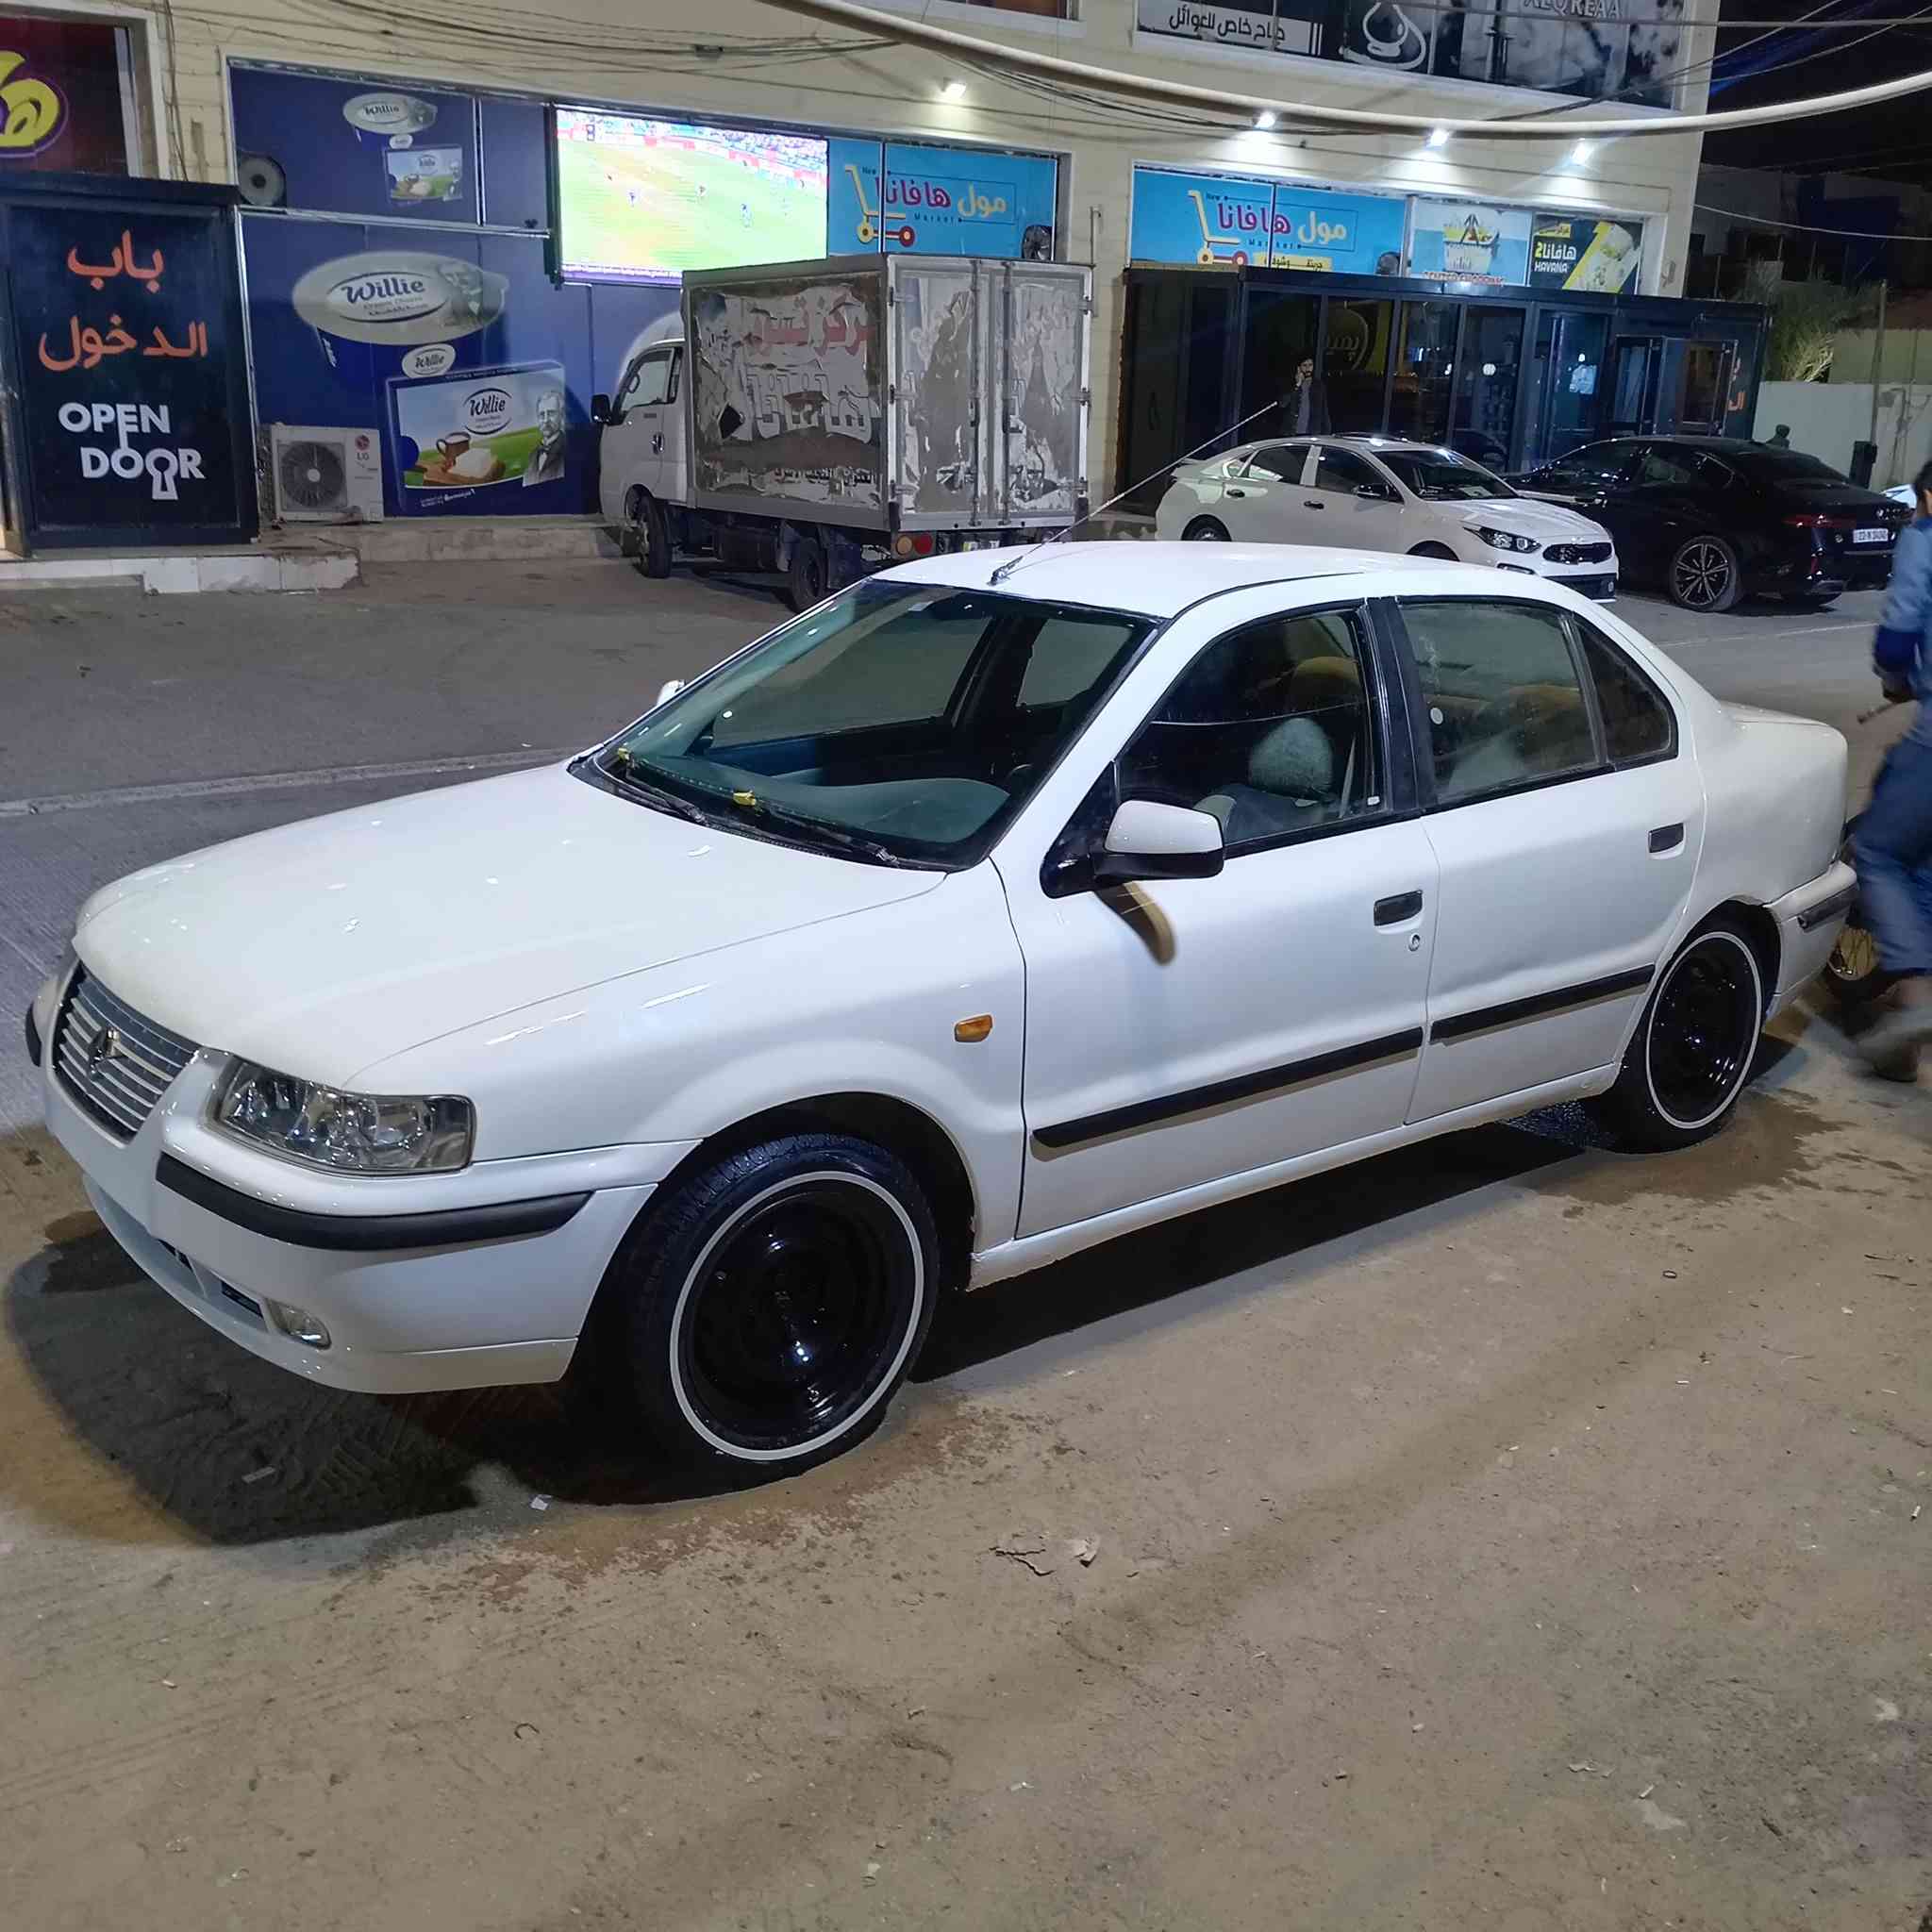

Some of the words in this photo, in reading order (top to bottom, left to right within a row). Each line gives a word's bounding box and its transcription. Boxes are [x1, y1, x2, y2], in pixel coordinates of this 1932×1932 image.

[1169, 4, 1215, 32] للعوائل
[1217, 17, 1252, 37] خاص
[1254, 22, 1285, 46] جاح
[874, 175, 952, 208] هافانا
[958, 181, 1008, 218] مول
[1217, 201, 1291, 235] هافانا
[1297, 210, 1347, 244] مول
[67, 229, 165, 294] باب
[1534, 260, 1570, 275] HAVANA
[342, 275, 425, 304] Willie
[38, 312, 208, 372] الدخول
[58, 402, 172, 435] OPEN
[470, 394, 506, 417] Willie
[79, 447, 207, 501] DOOR
